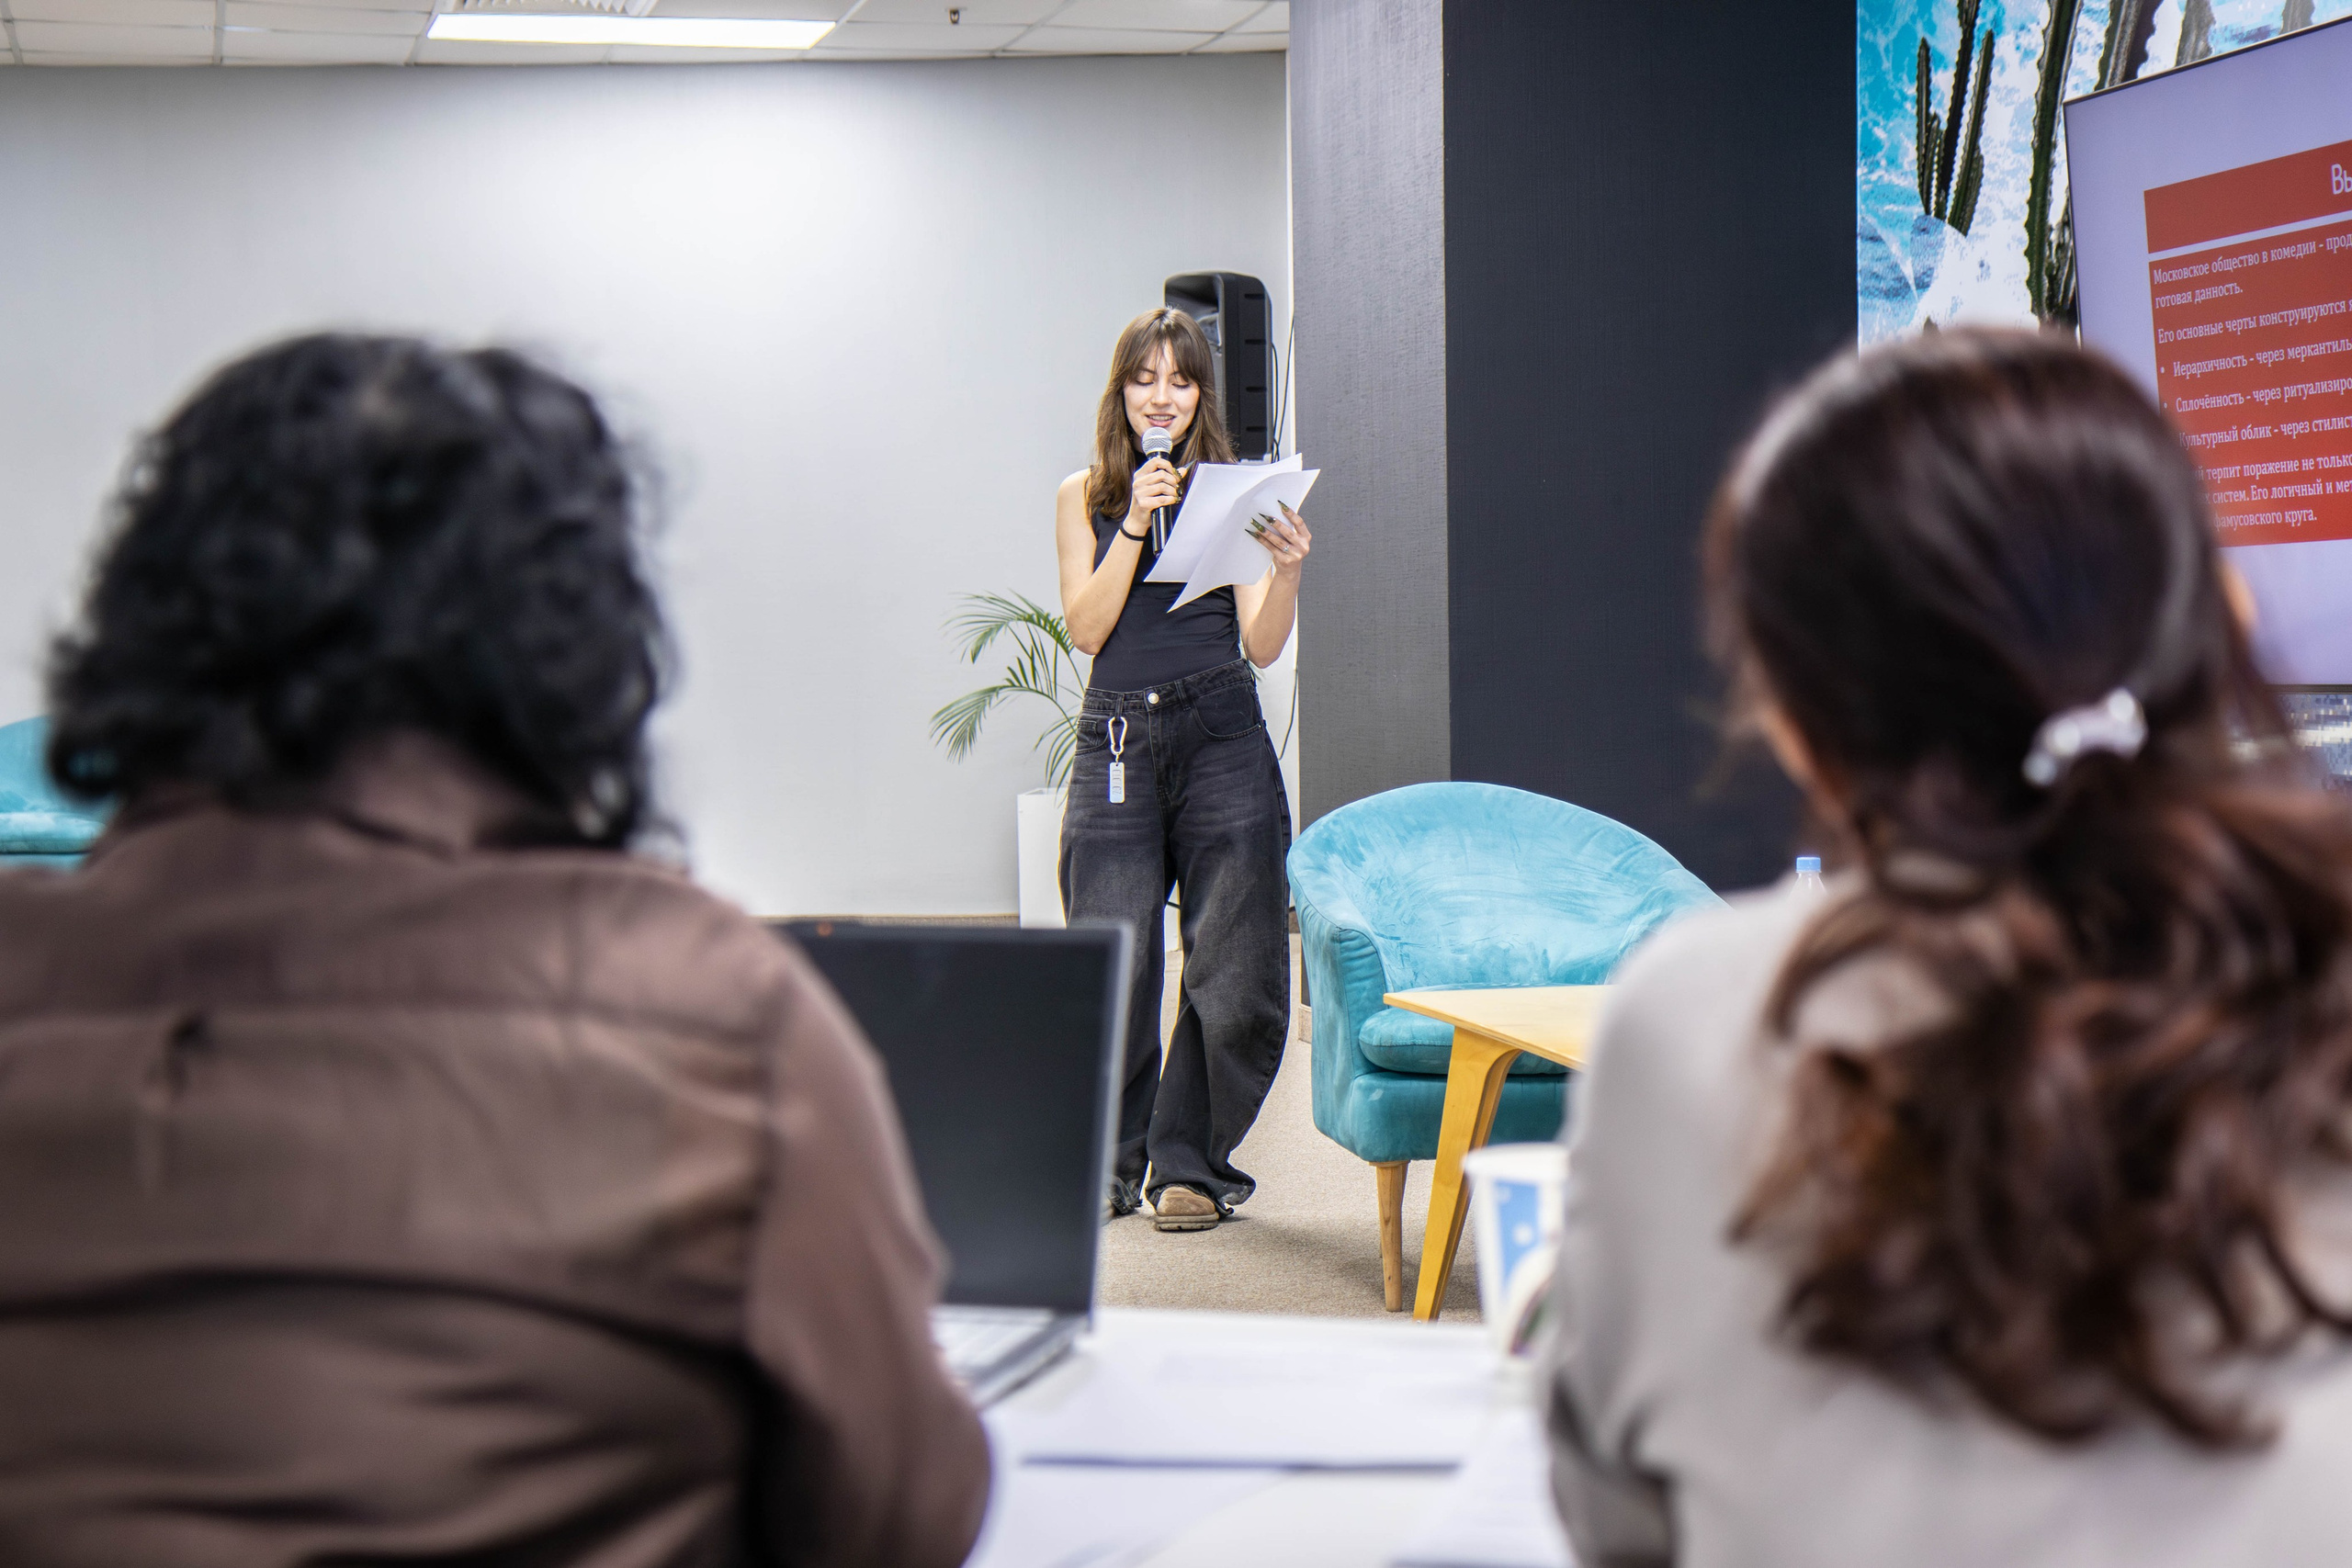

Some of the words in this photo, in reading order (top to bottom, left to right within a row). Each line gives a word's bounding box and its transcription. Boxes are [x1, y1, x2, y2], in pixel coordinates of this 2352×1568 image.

[2154, 263, 2210, 285] Московское
[2211, 255, 2259, 273] общество
[2262, 251, 2268, 264] в
[2270, 241, 2316, 259] комедии
[2155, 291, 2193, 309] готовая
[2194, 282, 2243, 304] данность.
[2158, 328, 2175, 344] Его
[2177, 321, 2223, 340] основные
[2225, 316, 2256, 335] черты
[2259, 300, 2346, 326] конструируются
[2173, 355, 2247, 379] Иерархичность
[2256, 348, 2285, 367] через
[2176, 392, 2245, 412] Сплочённость
[2253, 387, 2281, 405] через
[2241, 423, 2272, 440] облик
[2280, 421, 2310, 439] через
[2206, 466, 2241, 484] терпит
[2243, 459, 2300, 479] поражение
[2301, 458, 2314, 471] не
[2212, 490, 2249, 504] систем.
[2250, 484, 2268, 501] Его
[2270, 479, 2324, 499] логичный
[2325, 481, 2333, 494] и
[2284, 509, 2317, 527] круга.
